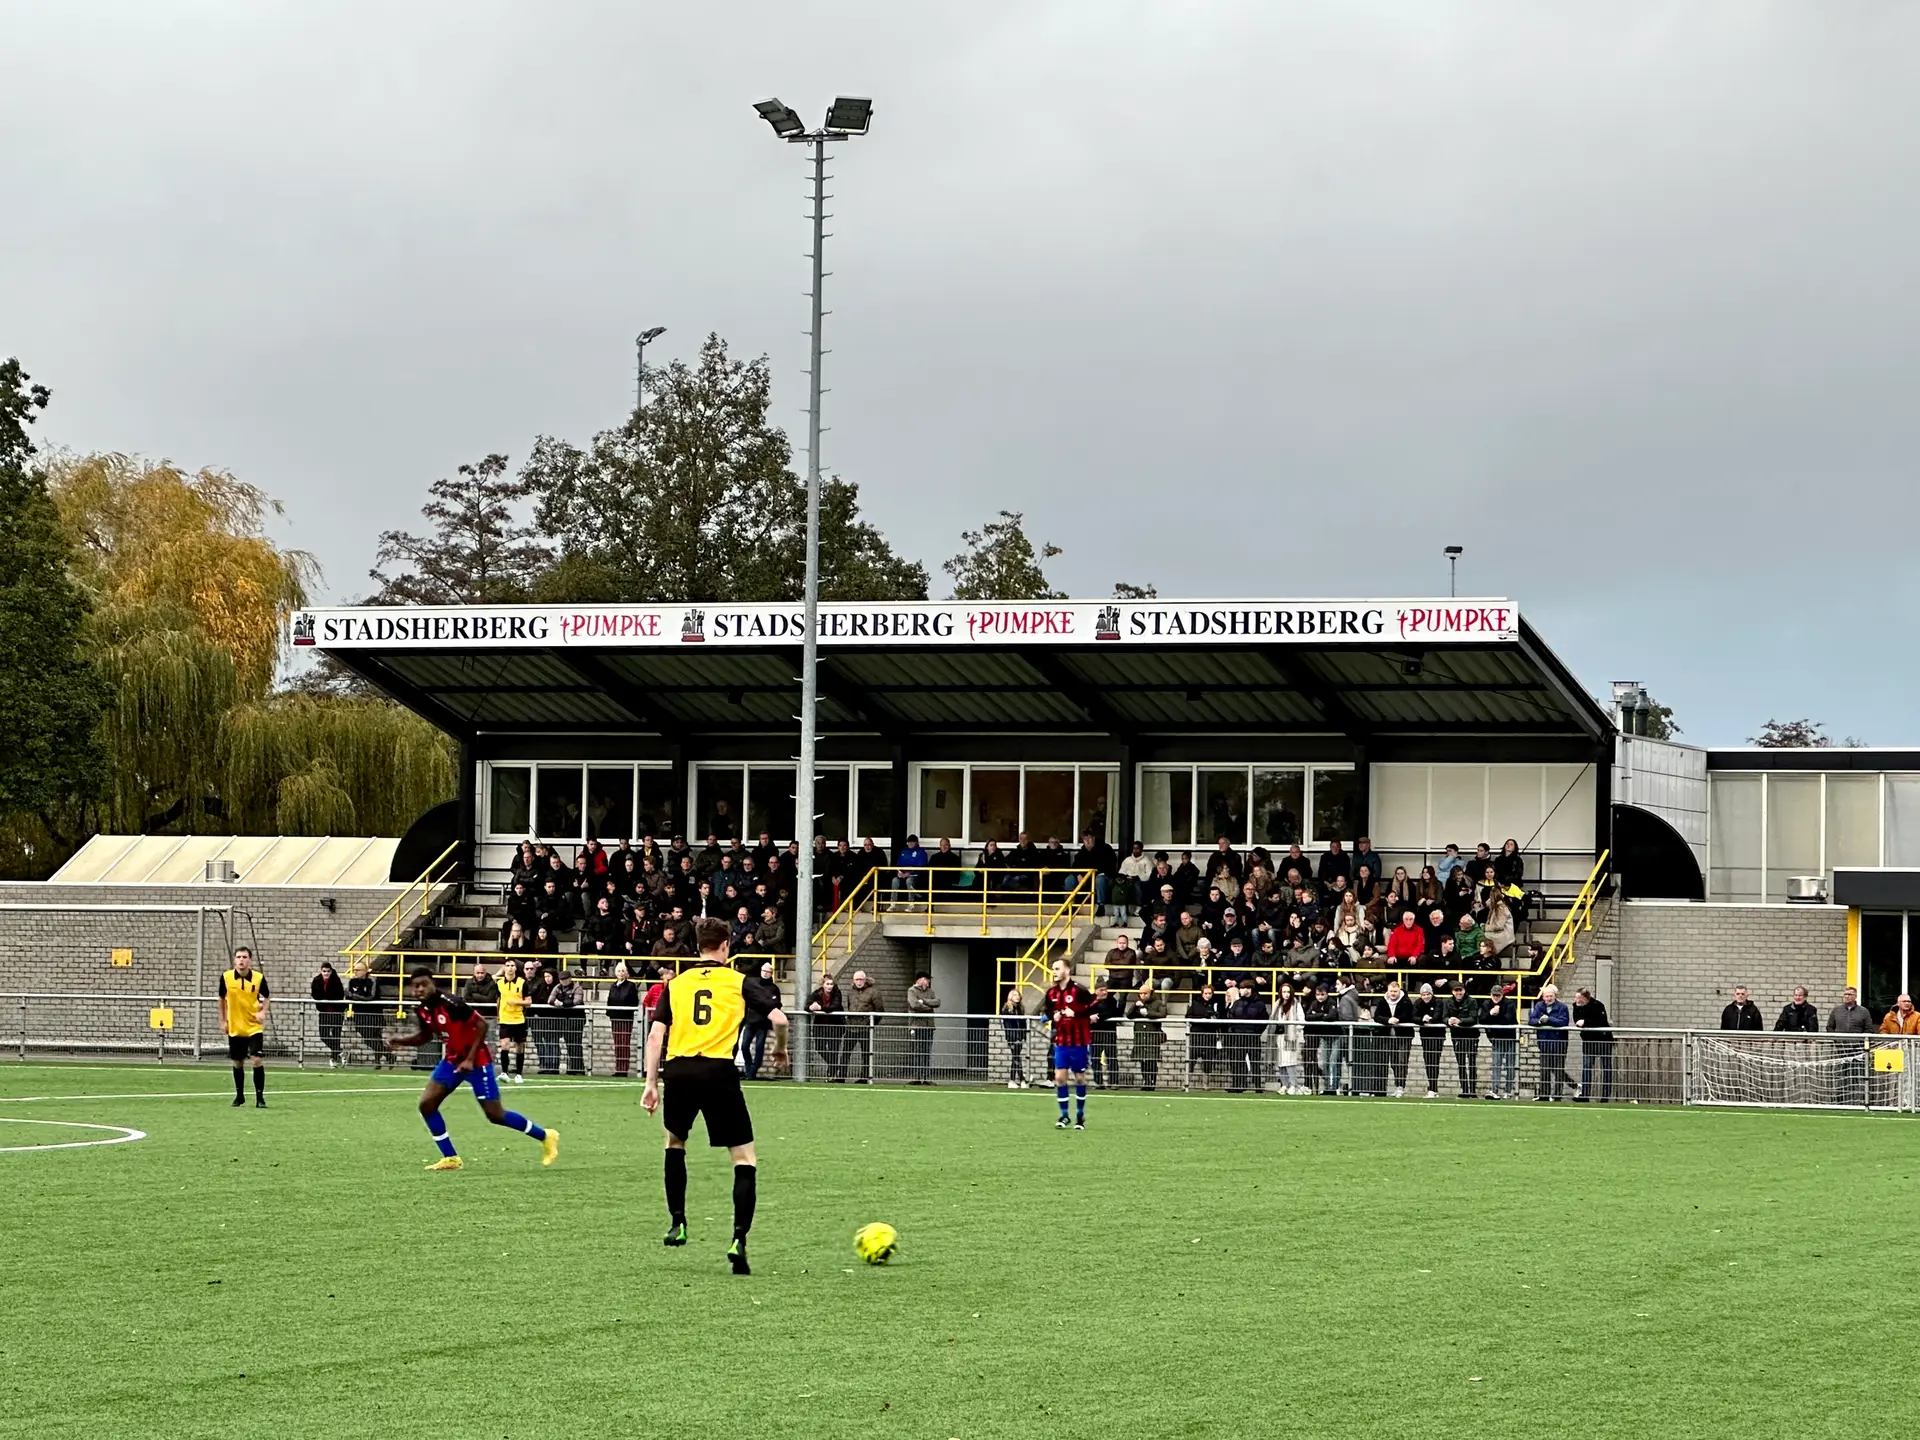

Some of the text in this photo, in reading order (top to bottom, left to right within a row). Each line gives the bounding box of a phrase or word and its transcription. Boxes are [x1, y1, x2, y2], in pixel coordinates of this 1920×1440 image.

[324, 615, 549, 641] STADSHERBERG
[713, 612, 954, 637] STADSHERBERG
[1130, 609, 1385, 635] STADSHERBERG
[693, 989, 713, 1026] 6
